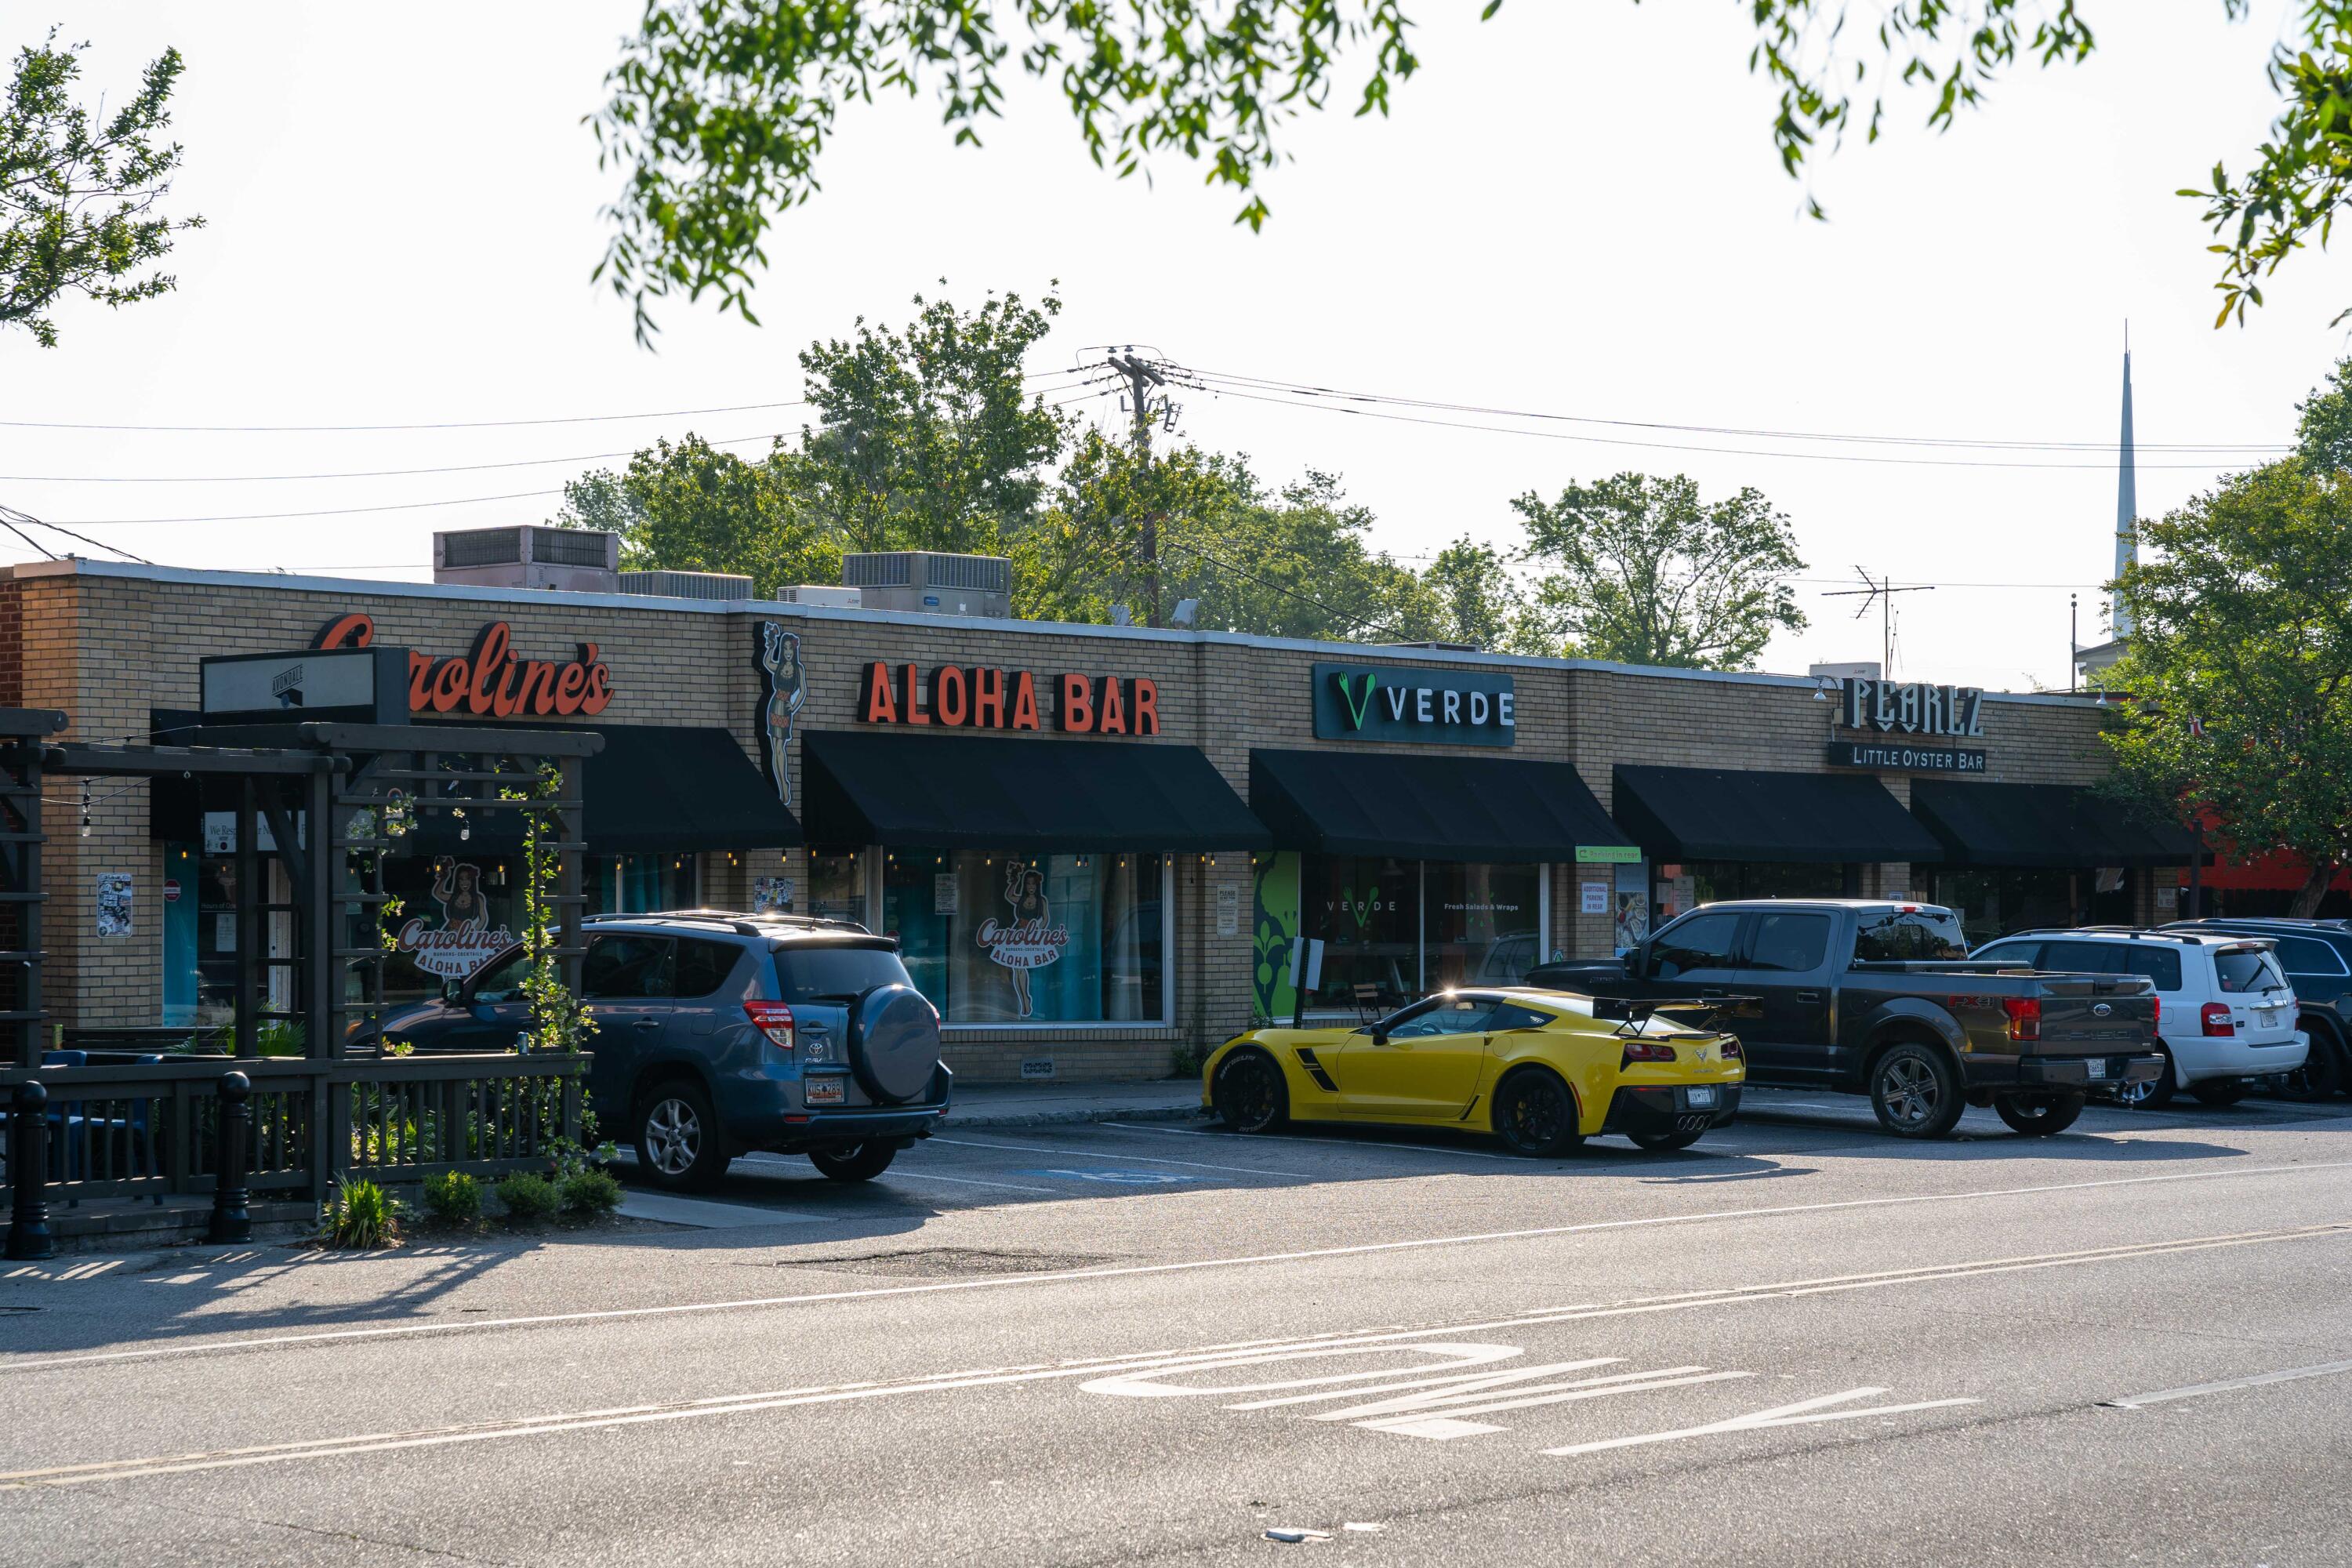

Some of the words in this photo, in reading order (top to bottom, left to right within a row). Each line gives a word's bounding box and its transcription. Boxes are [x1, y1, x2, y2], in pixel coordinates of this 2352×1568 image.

[318, 613, 615, 717] roline's
[271, 666, 303, 694] AVONDALE
[867, 660, 1040, 731] ALOHA
[1063, 673, 1160, 735] BAR
[1385, 685, 1515, 727] VERDE
[1851, 677, 1985, 738] PEARLZ
[1853, 746, 1899, 765] LITTLE
[1903, 750, 1953, 768] OYSTER
[1958, 752, 1984, 770] BAR
[209, 825, 221, 836] We
[1589, 850, 1616, 860] Parking
[1326, 901, 1396, 911] VERDE
[1444, 902, 1464, 911] Fresh
[1465, 902, 1489, 911] Salads
[1496, 903, 1519, 913] Wraps
[397, 918, 513, 951] Caroline's
[977, 918, 1069, 947] Caroline's
[417, 954, 463, 974] ALOHA
[993, 949, 1029, 967] ALOHA
[1033, 949, 1057, 966] BAR
[1947, 995, 1994, 1008] FX4
[827, 1083, 841, 1095] 289
[1077, 1341, 1986, 1457] ONLY
